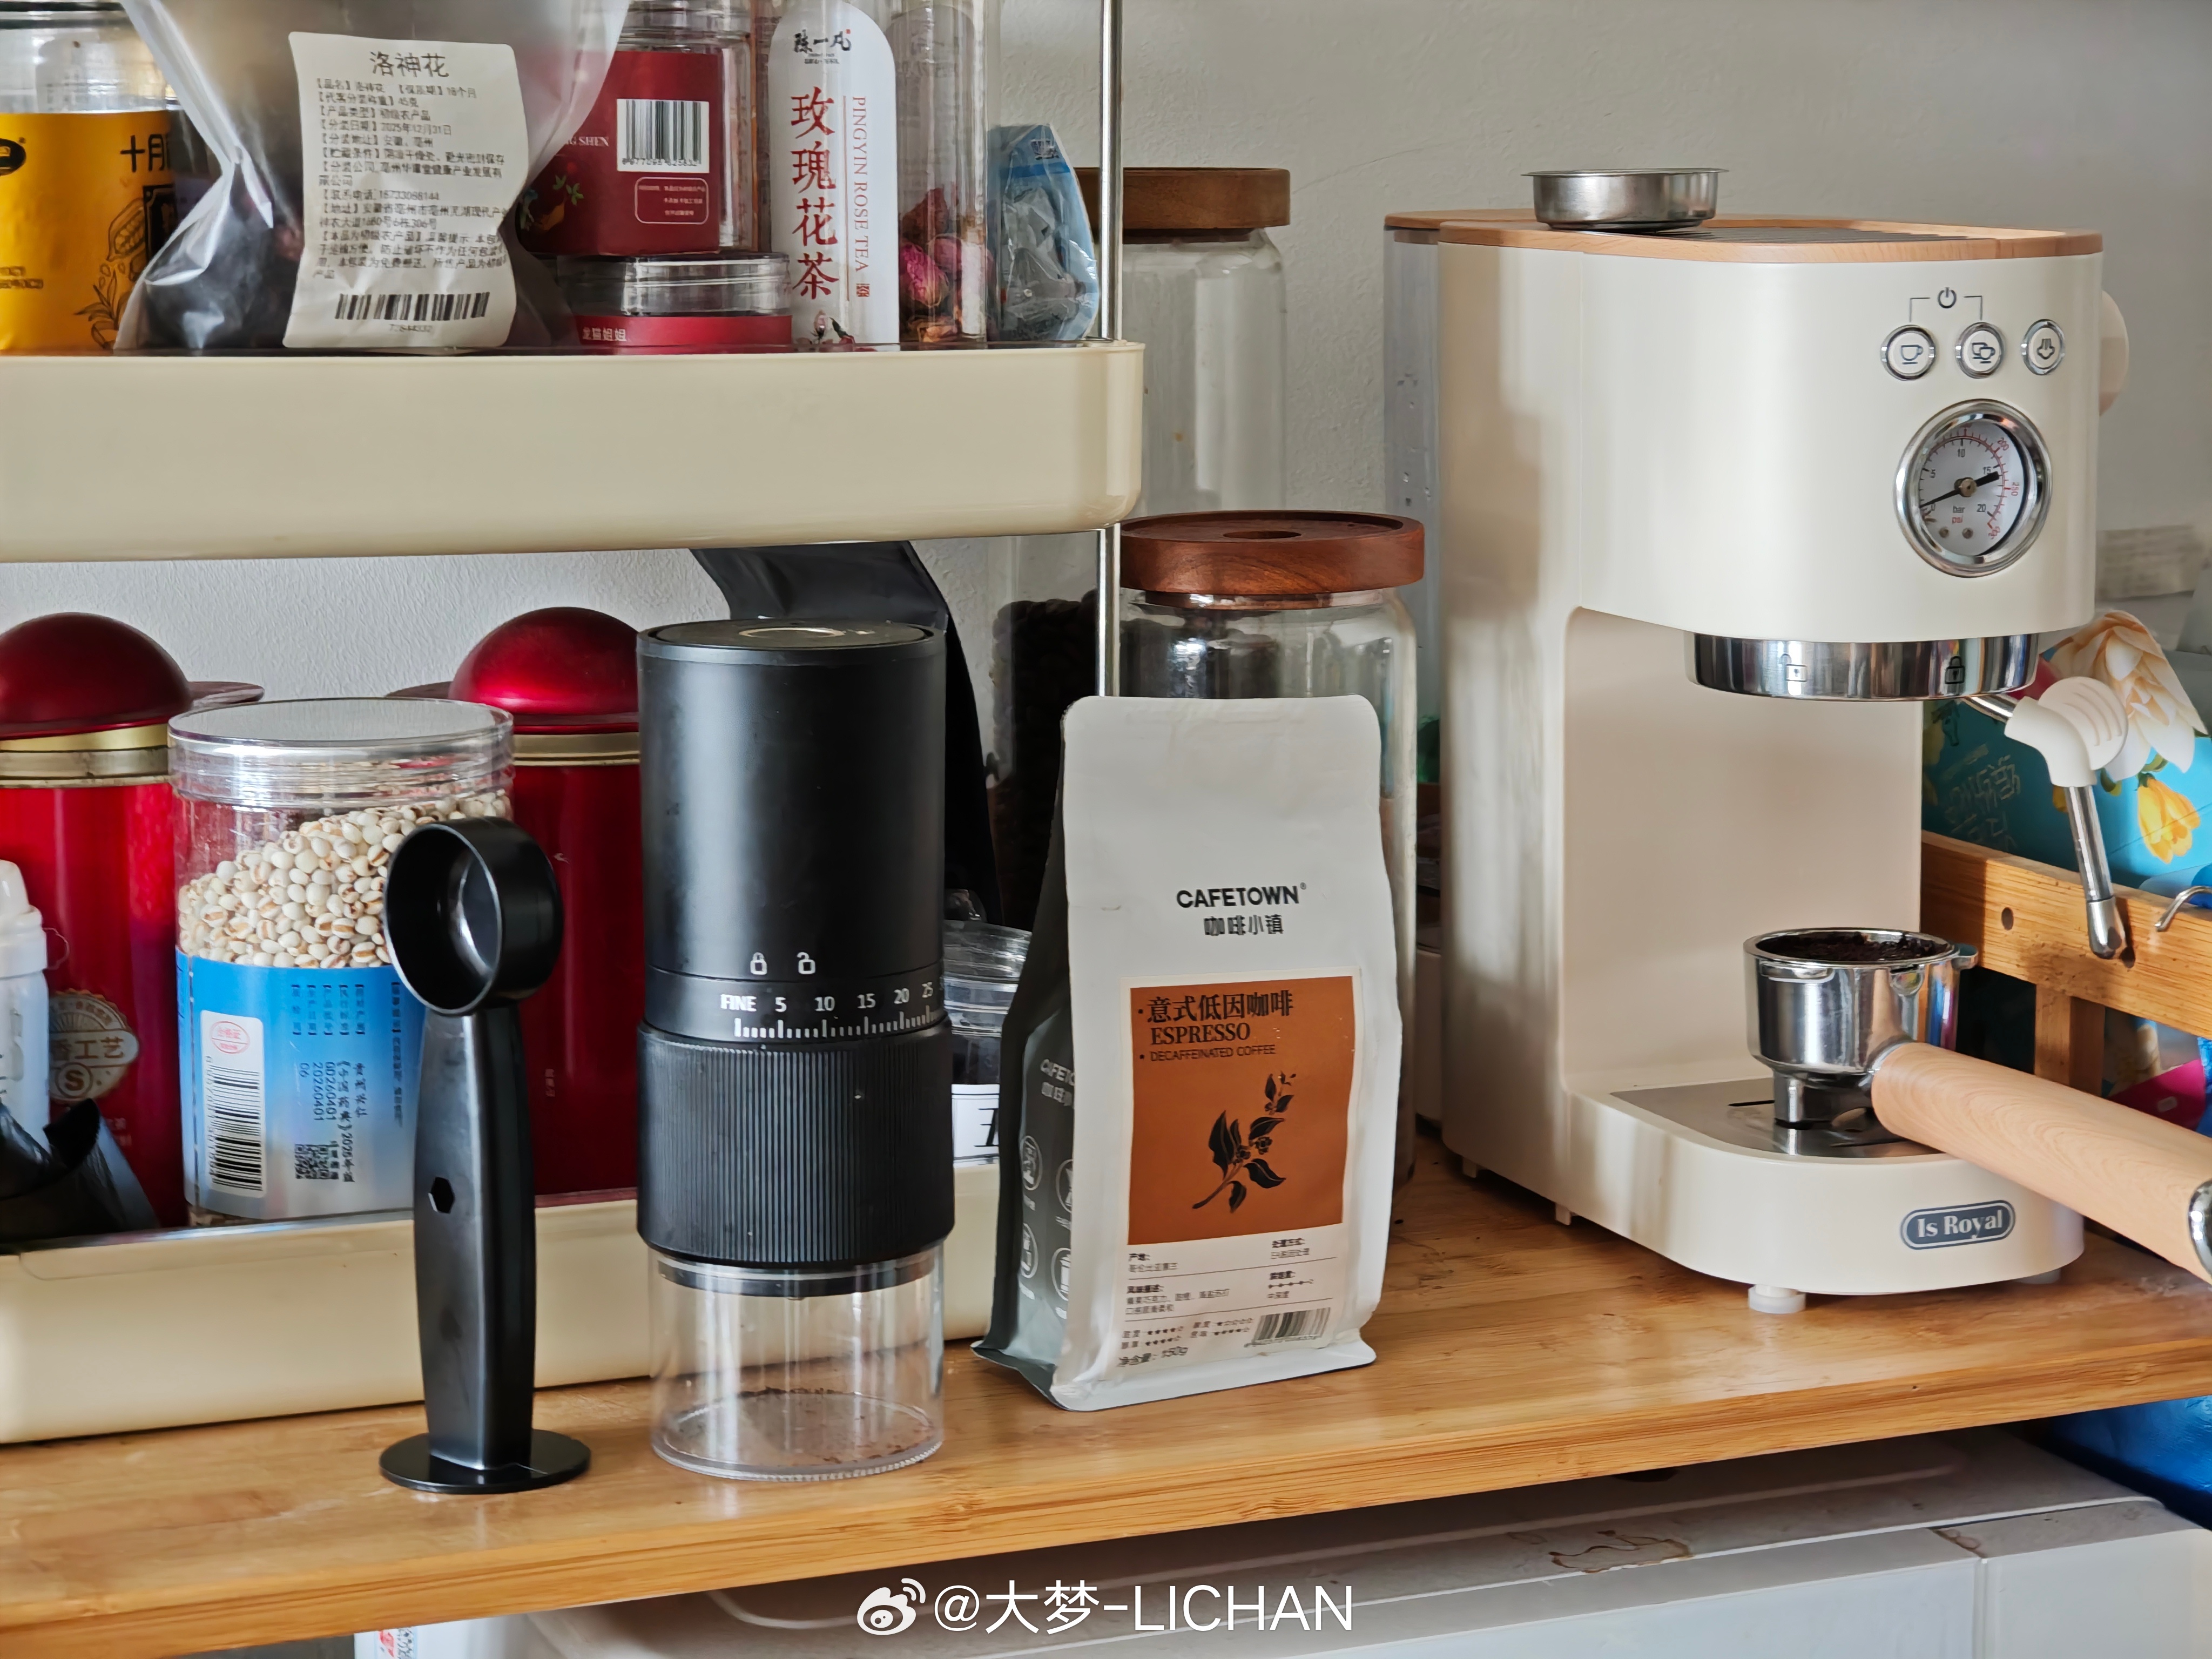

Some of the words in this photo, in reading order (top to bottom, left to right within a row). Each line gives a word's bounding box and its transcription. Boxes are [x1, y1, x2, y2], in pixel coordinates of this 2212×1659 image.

[369, 51, 450, 78] 洛神花
[578, 136, 609, 146] SHEN
[852, 96, 868, 176] PINGYIN
[790, 86, 840, 300] 玫瑰花茶
[853, 181, 869, 230] ROSE
[854, 235, 869, 272] TEA
[1957, 448, 1966, 458] 10
[1929, 469, 1936, 478] 5
[1982, 466, 1991, 475] 15
[1952, 505, 1965, 514] bar
[1977, 503, 1986, 512] 20
[1176, 885, 1300, 908] CAFETOWN
[1203, 914, 1284, 936] 咖啡小镇
[720, 994, 757, 1012] FINE
[775, 996, 787, 1013] 5
[814, 996, 835, 1012] 10
[857, 993, 876, 1009] 15
[893, 988, 911, 1005] 20
[921, 981, 934, 998] 25
[1147, 989, 1294, 1023] 意式低因咖啡
[1150, 1022, 1251, 1046] ESPRESSO
[1150, 1047, 1234, 1062] DECAFFEINATED
[1237, 1044, 1277, 1056] COFFEE
[1917, 1218, 1938, 1238] Is
[1944, 1209, 2003, 1239] Royal
